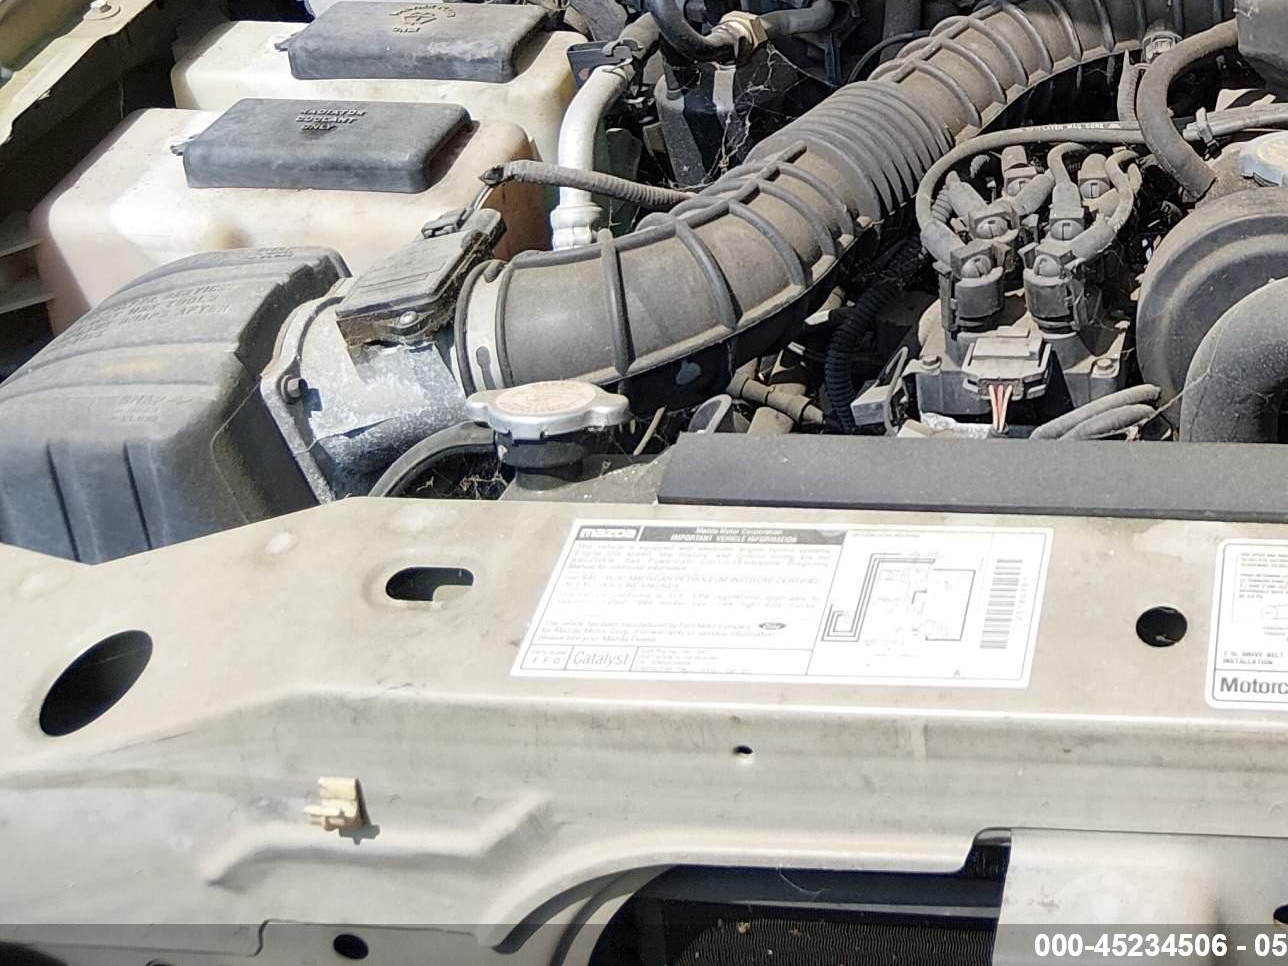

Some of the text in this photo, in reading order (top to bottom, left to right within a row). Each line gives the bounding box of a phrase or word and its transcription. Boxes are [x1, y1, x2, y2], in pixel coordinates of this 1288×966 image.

[300, 108, 368, 117] RADIATOR
[296, 115, 357, 124] COOLANT
[301, 123, 337, 131] ONLY
[578, 528, 637, 539] mazda
[746, 535, 798, 543] INFORMATION
[569, 649, 631, 668] Catalyst
